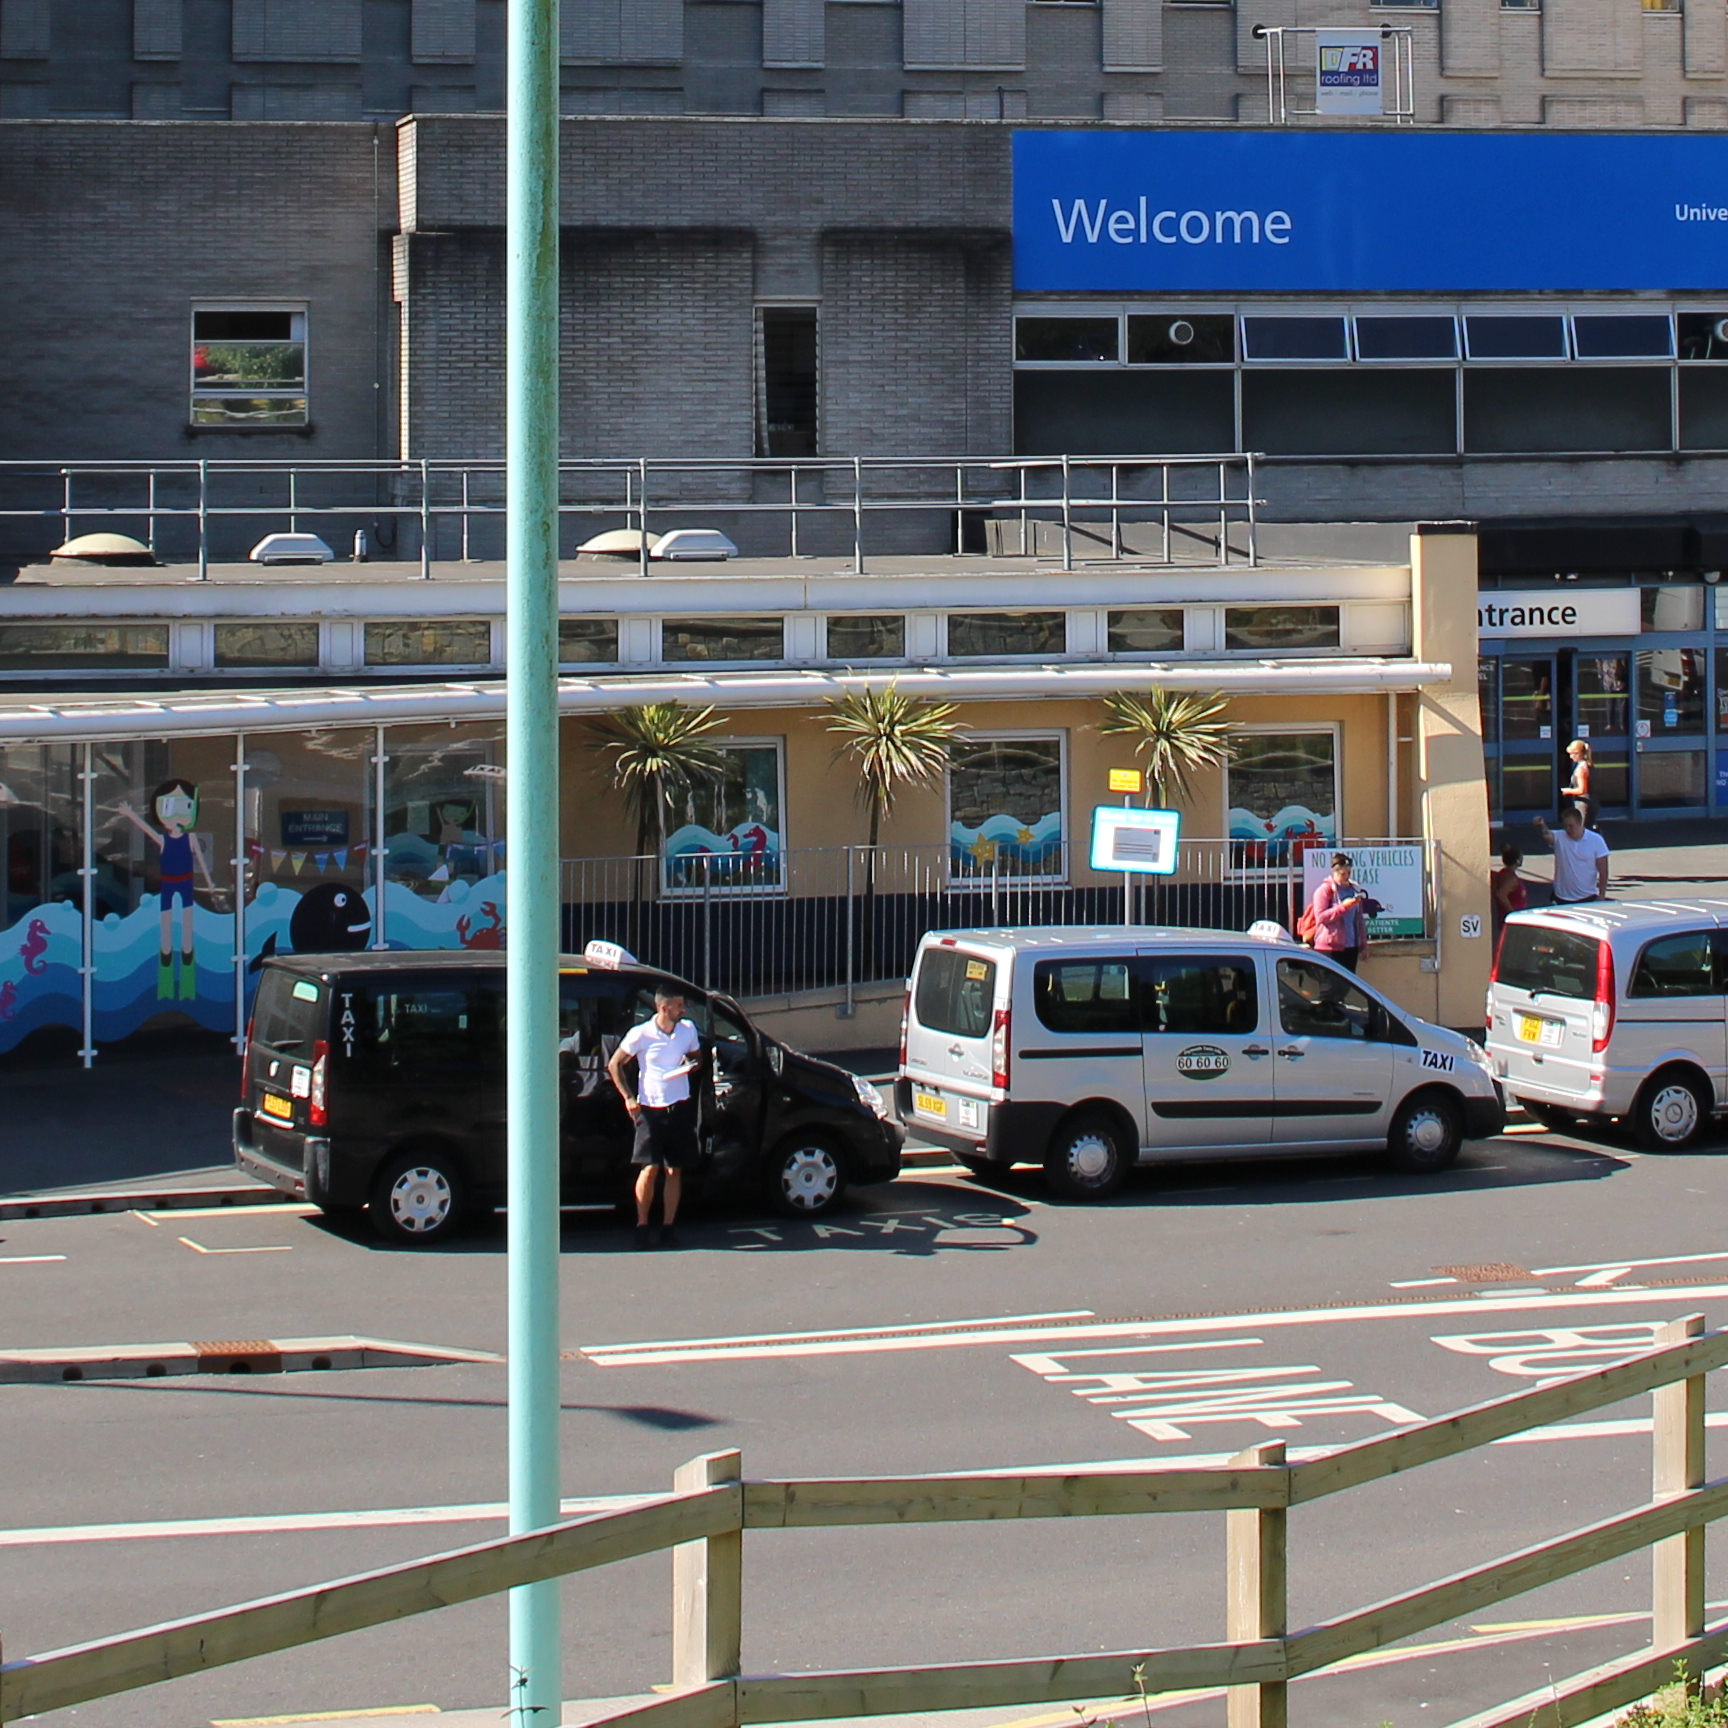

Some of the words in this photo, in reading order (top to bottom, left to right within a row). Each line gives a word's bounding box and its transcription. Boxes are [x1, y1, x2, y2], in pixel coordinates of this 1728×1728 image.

[1322, 47, 1374, 71] DFR
[1322, 73, 1360, 86] roofing
[1363, 73, 1377, 84] ltd
[1051, 195, 1292, 244] Welcome
[303, 813, 329, 822] MAIN
[288, 822, 344, 833] ENTRANCE
[1312, 852, 1326, 868] NO
[1369, 850, 1414, 866] VEHICLES
[1352, 868, 1379, 884] LEASE
[1255, 922, 1277, 933] TAXI
[1462, 920, 1479, 933] SV
[591, 943, 618, 958] TAXI
[404, 1004, 427, 1013] TAXI
[341, 993, 355, 1058] TAXI
[1178, 1057, 1192, 1070] 60
[1197, 1057, 1211, 1069] 60
[1215, 1057, 1229, 1069] 60
[1422, 1050, 1454, 1072] TAXI
[727, 1213, 1016, 1241] TAXIS
[1009, 1338, 1429, 1442] LANE
